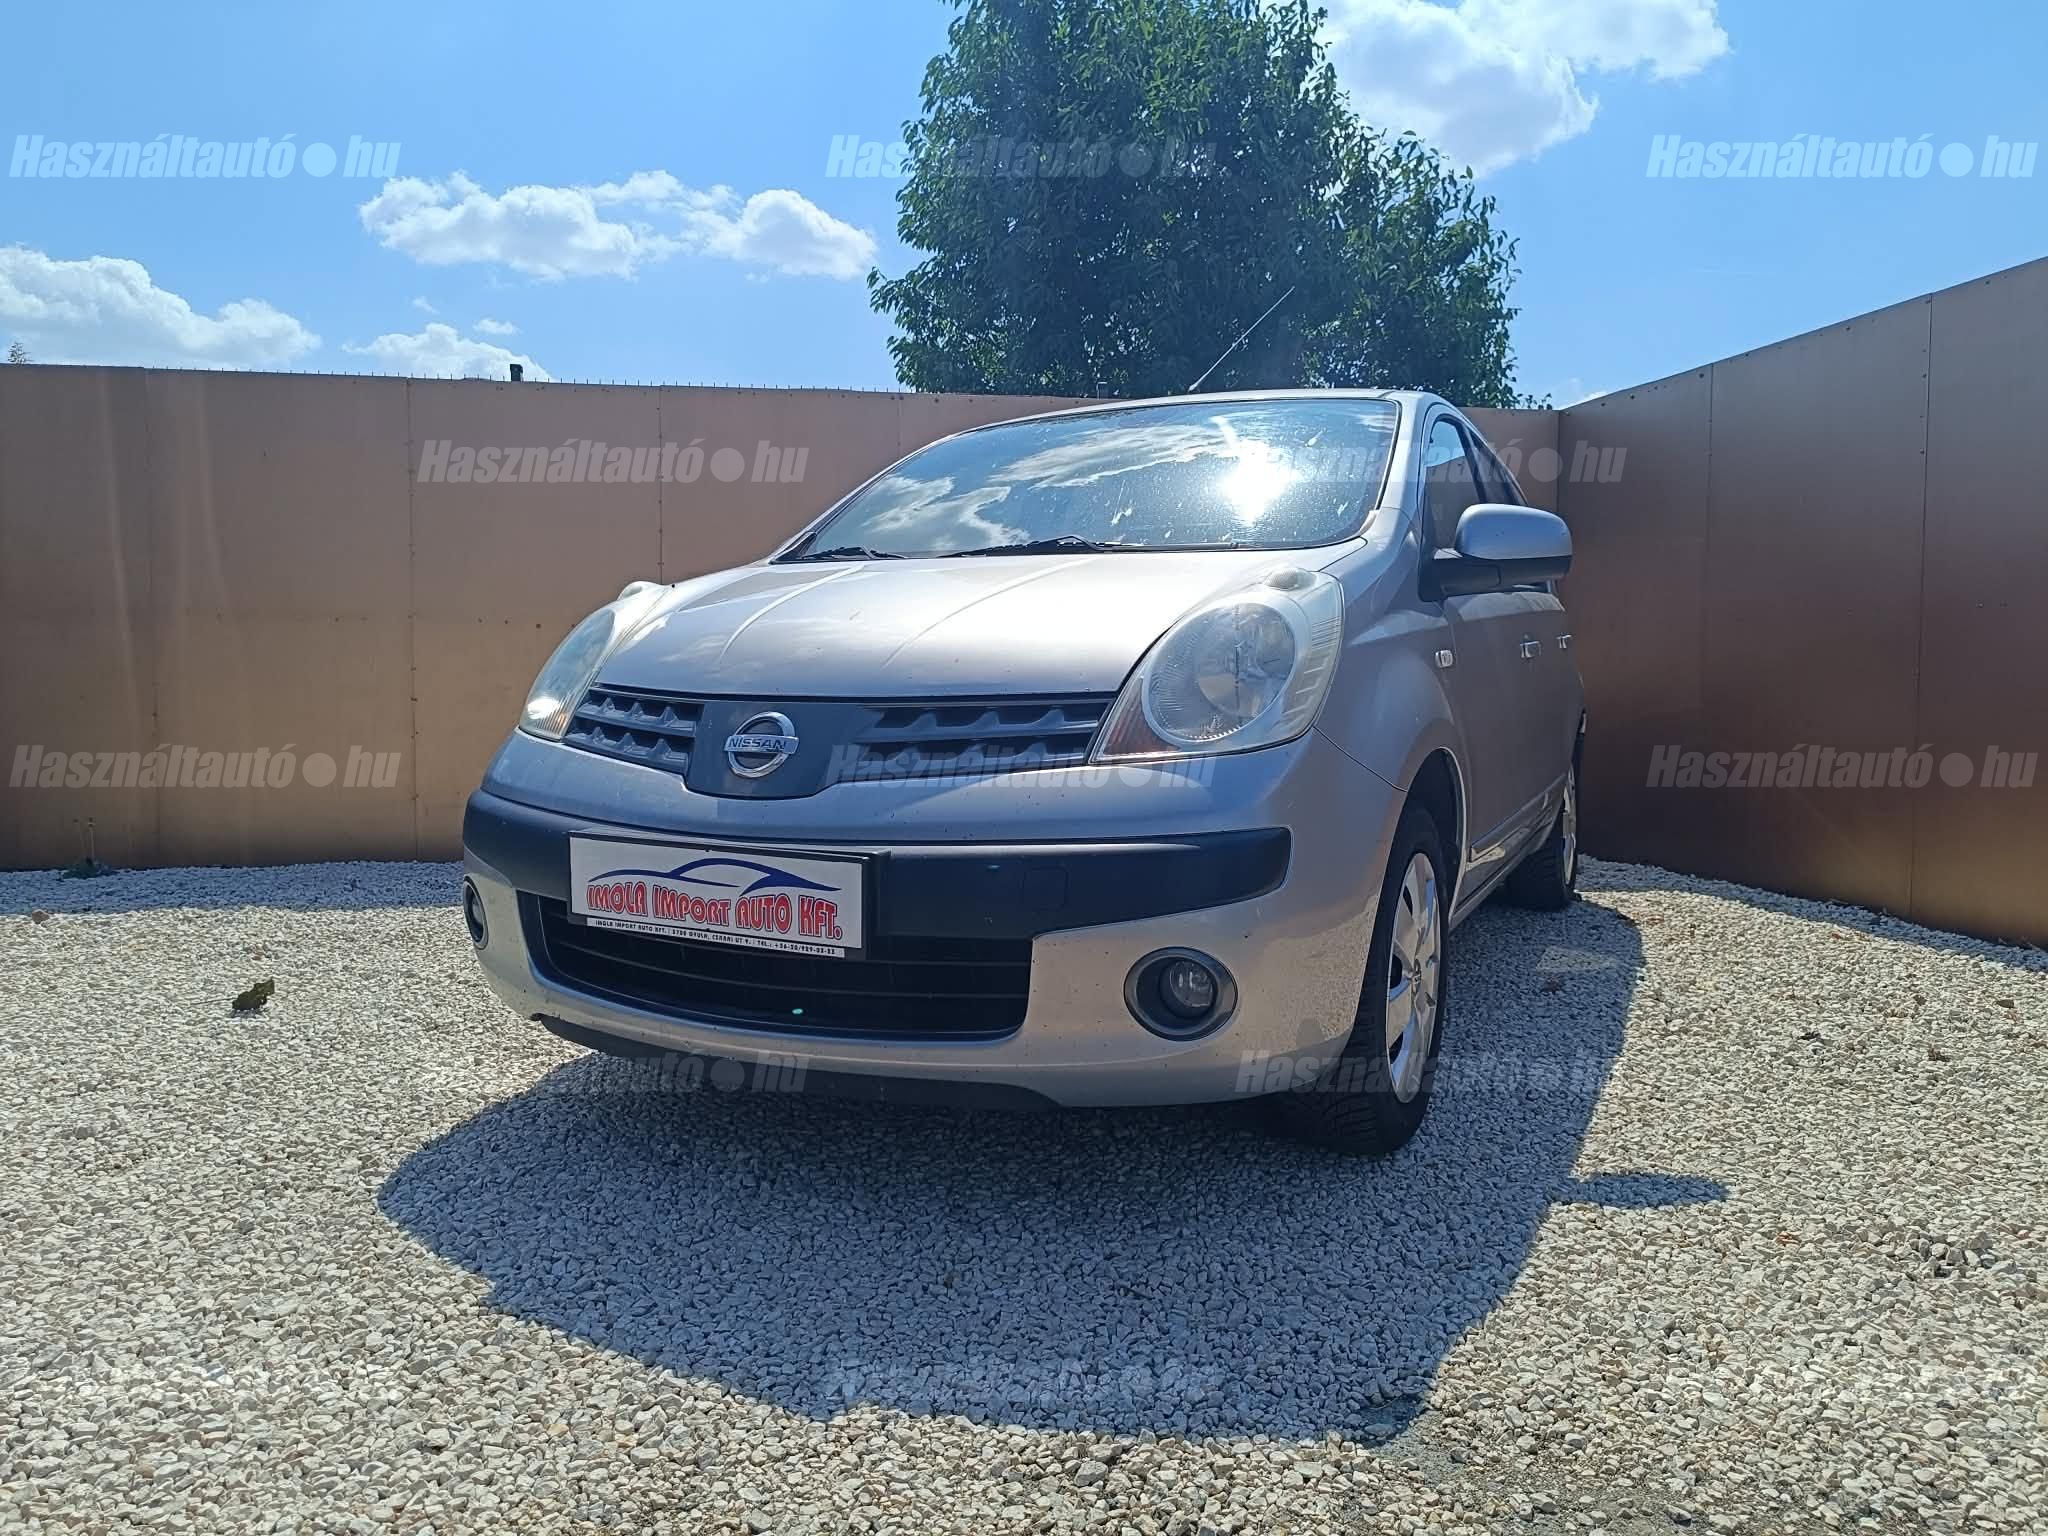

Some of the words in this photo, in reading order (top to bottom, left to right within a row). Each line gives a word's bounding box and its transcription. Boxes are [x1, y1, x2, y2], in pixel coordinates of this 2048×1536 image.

[728, 736, 787, 750] NISSAN
[735, 892, 793, 935] AUTO
[799, 895, 843, 940] KFT.
